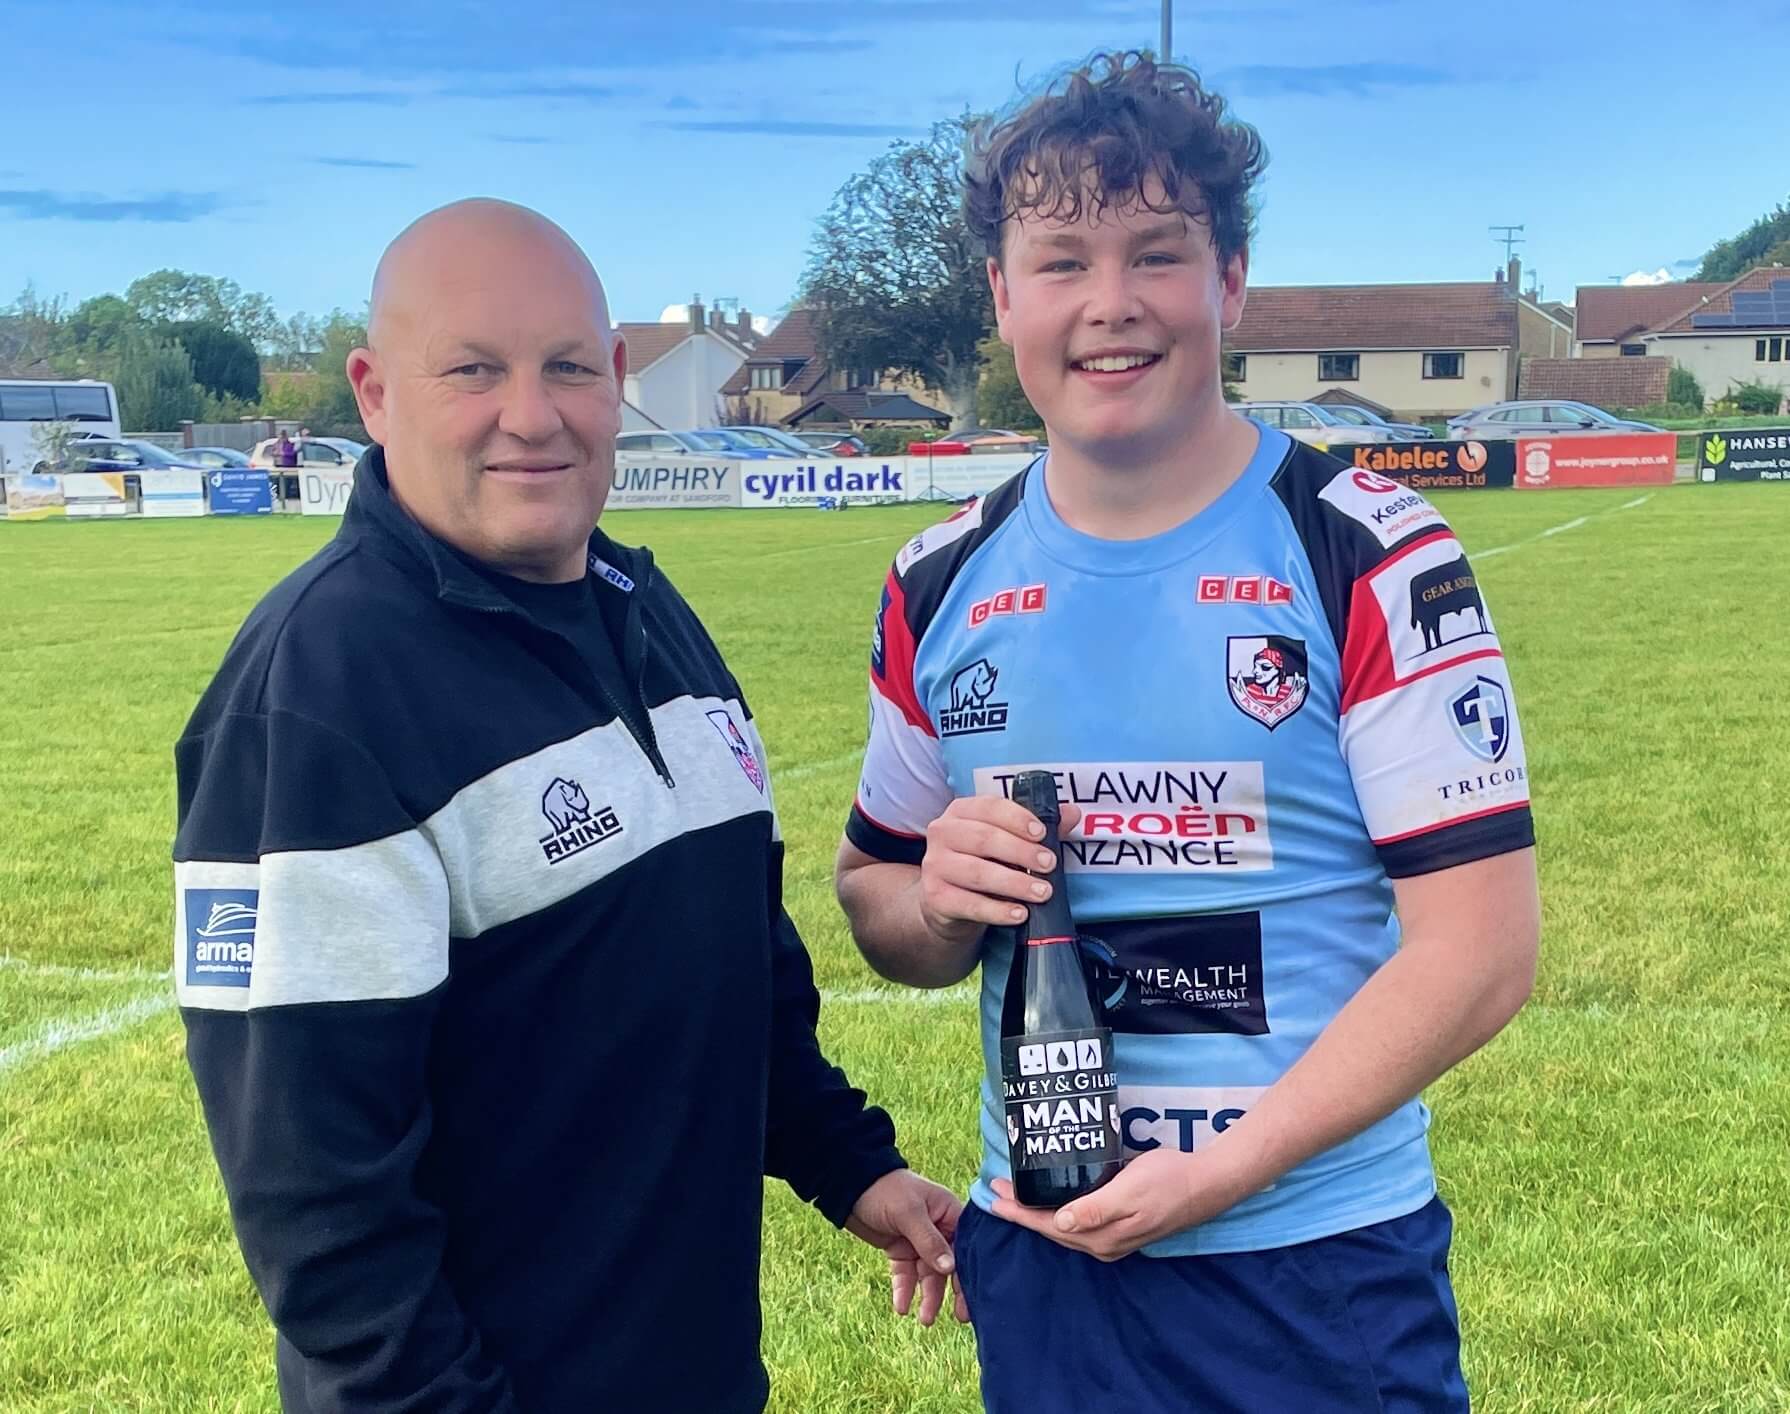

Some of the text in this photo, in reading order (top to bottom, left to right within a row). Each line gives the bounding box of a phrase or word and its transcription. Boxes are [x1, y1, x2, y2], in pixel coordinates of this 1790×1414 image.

[1730, 436, 1790, 450] HANSE
[1354, 446, 1449, 471] Kabelec
[612, 466, 729, 491] UMPHRY
[745, 464, 903, 500] cyril dark
[1411, 473, 1463, 489] Services
[1465, 472, 1486, 487] Ltd
[1203, 580, 1288, 601] CEF
[1422, 581, 1454, 602] GEAR
[970, 585, 1042, 625] CEF
[940, 709, 1008, 732] RHINO
[992, 771, 1228, 805] TELAWNY
[542, 812, 620, 860] RHINO
[196, 941, 253, 962] arma
[1126, 963, 1248, 989] WEALTH
[1140, 985, 1248, 1003] MAGEMENT
[1003, 1079, 1051, 1098] DAVEY
[1054, 1074, 1073, 1093] &
[1022, 1096, 1103, 1129] MAN
[1048, 1124, 1080, 1135] OF THE
[1025, 1130, 1106, 1156] MATCH
